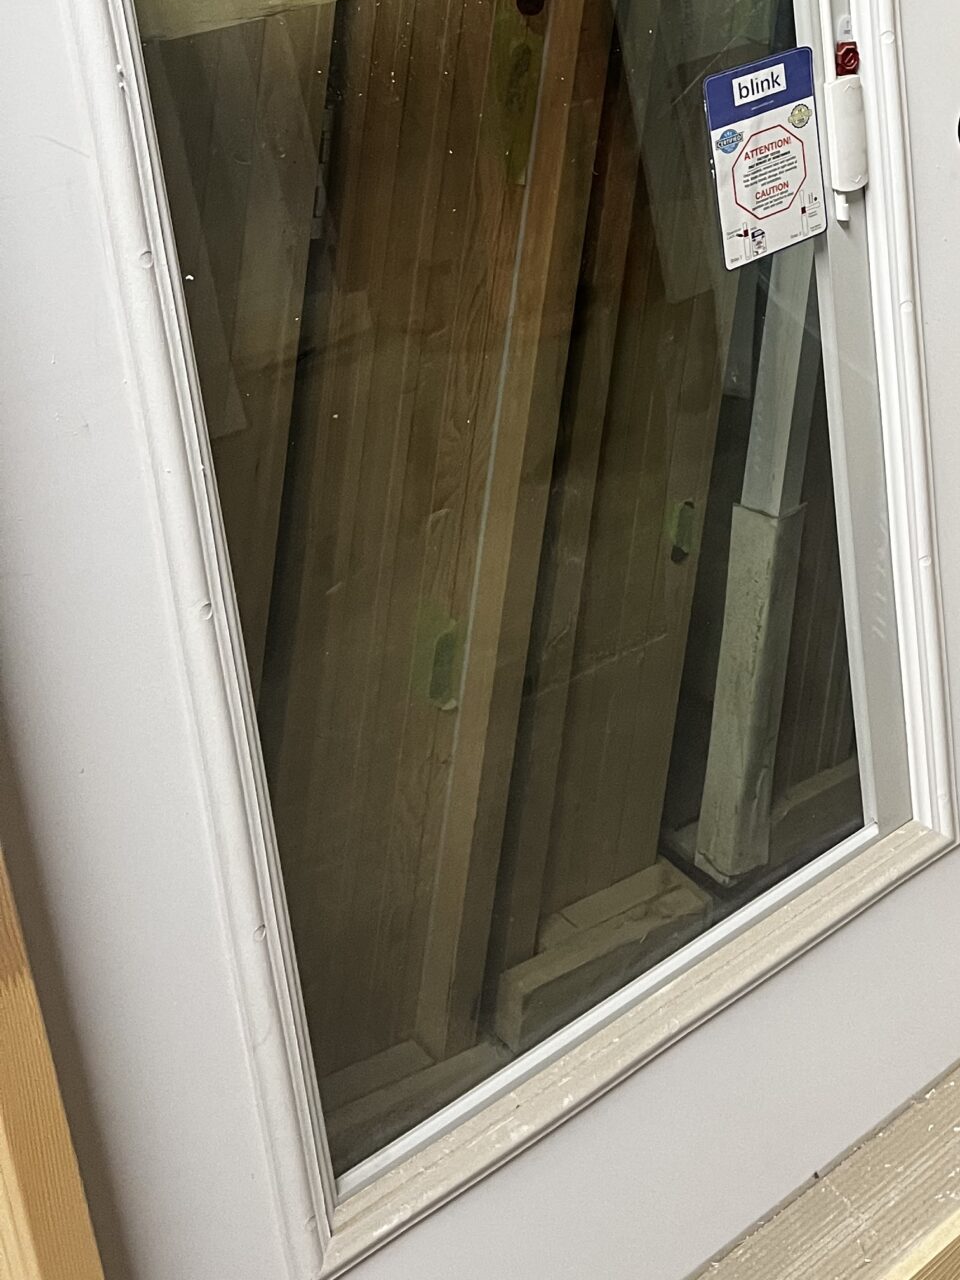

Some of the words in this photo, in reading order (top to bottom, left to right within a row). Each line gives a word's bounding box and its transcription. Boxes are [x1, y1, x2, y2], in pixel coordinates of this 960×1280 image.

[737, 70, 782, 100] blink
[744, 136, 793, 161] ATTENTION!
[755, 181, 790, 200] CAUTION
